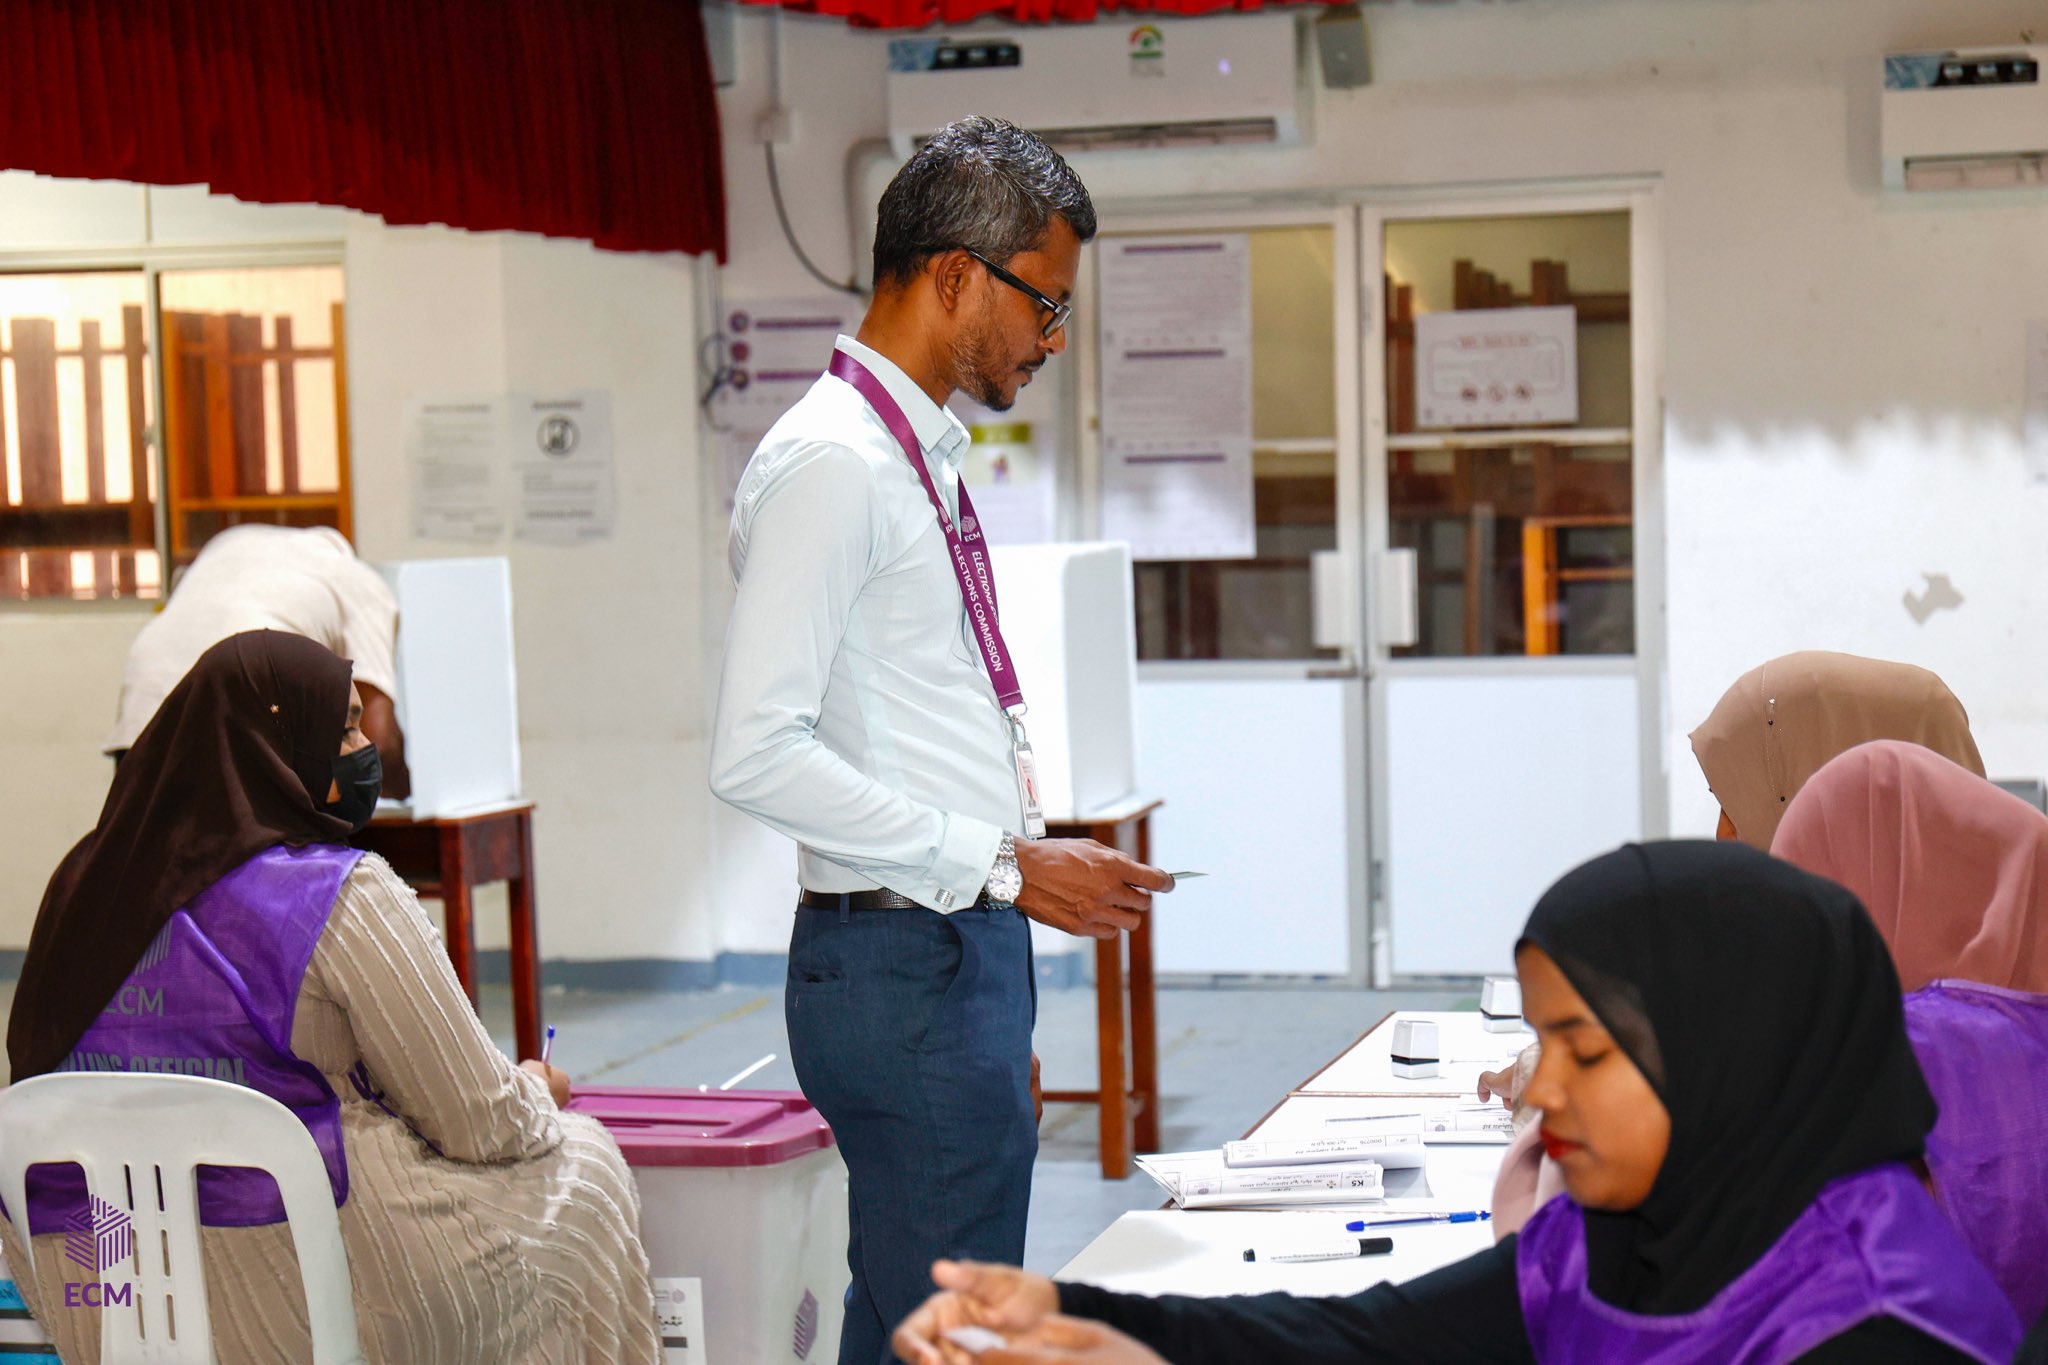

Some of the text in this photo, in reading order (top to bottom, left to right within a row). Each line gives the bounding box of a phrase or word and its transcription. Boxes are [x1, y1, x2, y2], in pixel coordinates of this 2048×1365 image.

[964, 531, 981, 543] ECM
[971, 550, 994, 605] ELECTIONS
[953, 543, 1004, 673] ELECTIONS COMMISSION
[104, 986, 164, 1017] CM
[129, 1055, 249, 1086] OFFICIAL
[1352, 1179, 1364, 1187] K5
